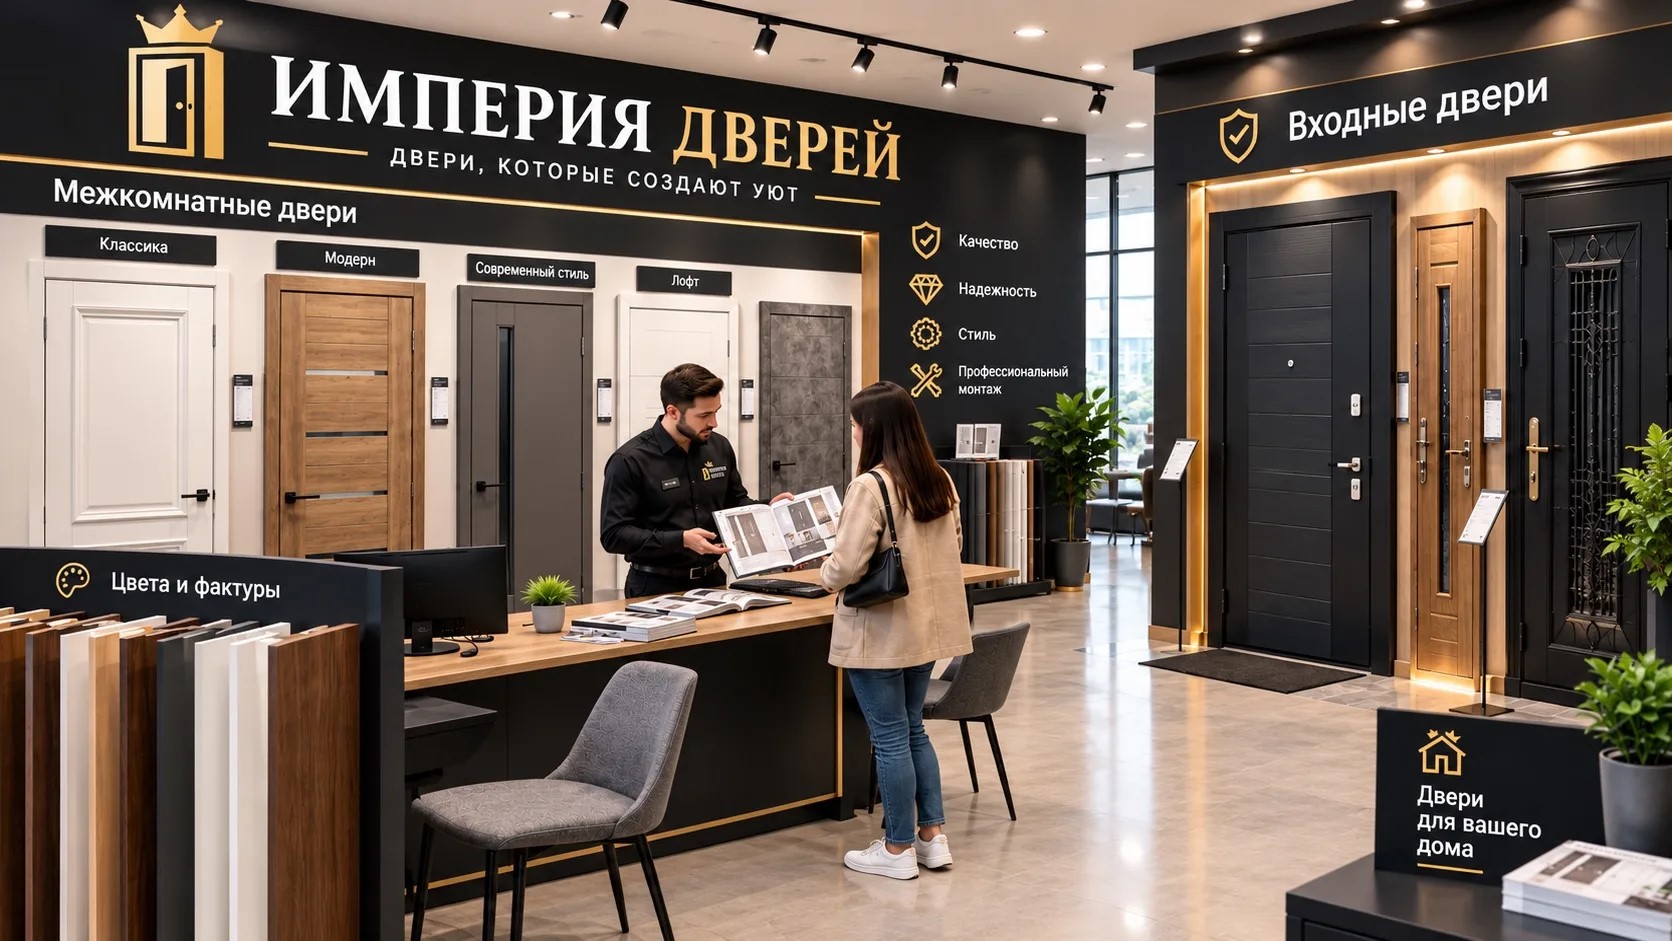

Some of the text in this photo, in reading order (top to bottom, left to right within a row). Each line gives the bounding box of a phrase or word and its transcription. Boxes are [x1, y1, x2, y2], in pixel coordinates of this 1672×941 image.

[271, 55, 900, 180] ИМПЕРИЯ ДВЕРЕЙ
[1289, 77, 1547, 141] Входные двери
[390, 148, 798, 202] ДВЕРИ, КОТОРЫЕ СОЗДАЮТ УЮТ
[55, 178, 356, 227] Межкомнатные двери
[100, 237, 168, 253] Классика
[960, 234, 1018, 250] Качество
[325, 251, 375, 268] Модерн
[476, 261, 590, 280] Современный стиль
[671, 275, 699, 288] Лофт
[959, 282, 1037, 297] Надежность
[958, 327, 997, 341] Стиль
[959, 365, 1068, 379] Профессиональный
[958, 385, 1002, 395] монтаж
[112, 572, 279, 602] Цвета и фактуры
[1417, 785, 1483, 811] Двери
[1417, 814, 1541, 838] для вашего
[1417, 839, 1473, 858] дома
